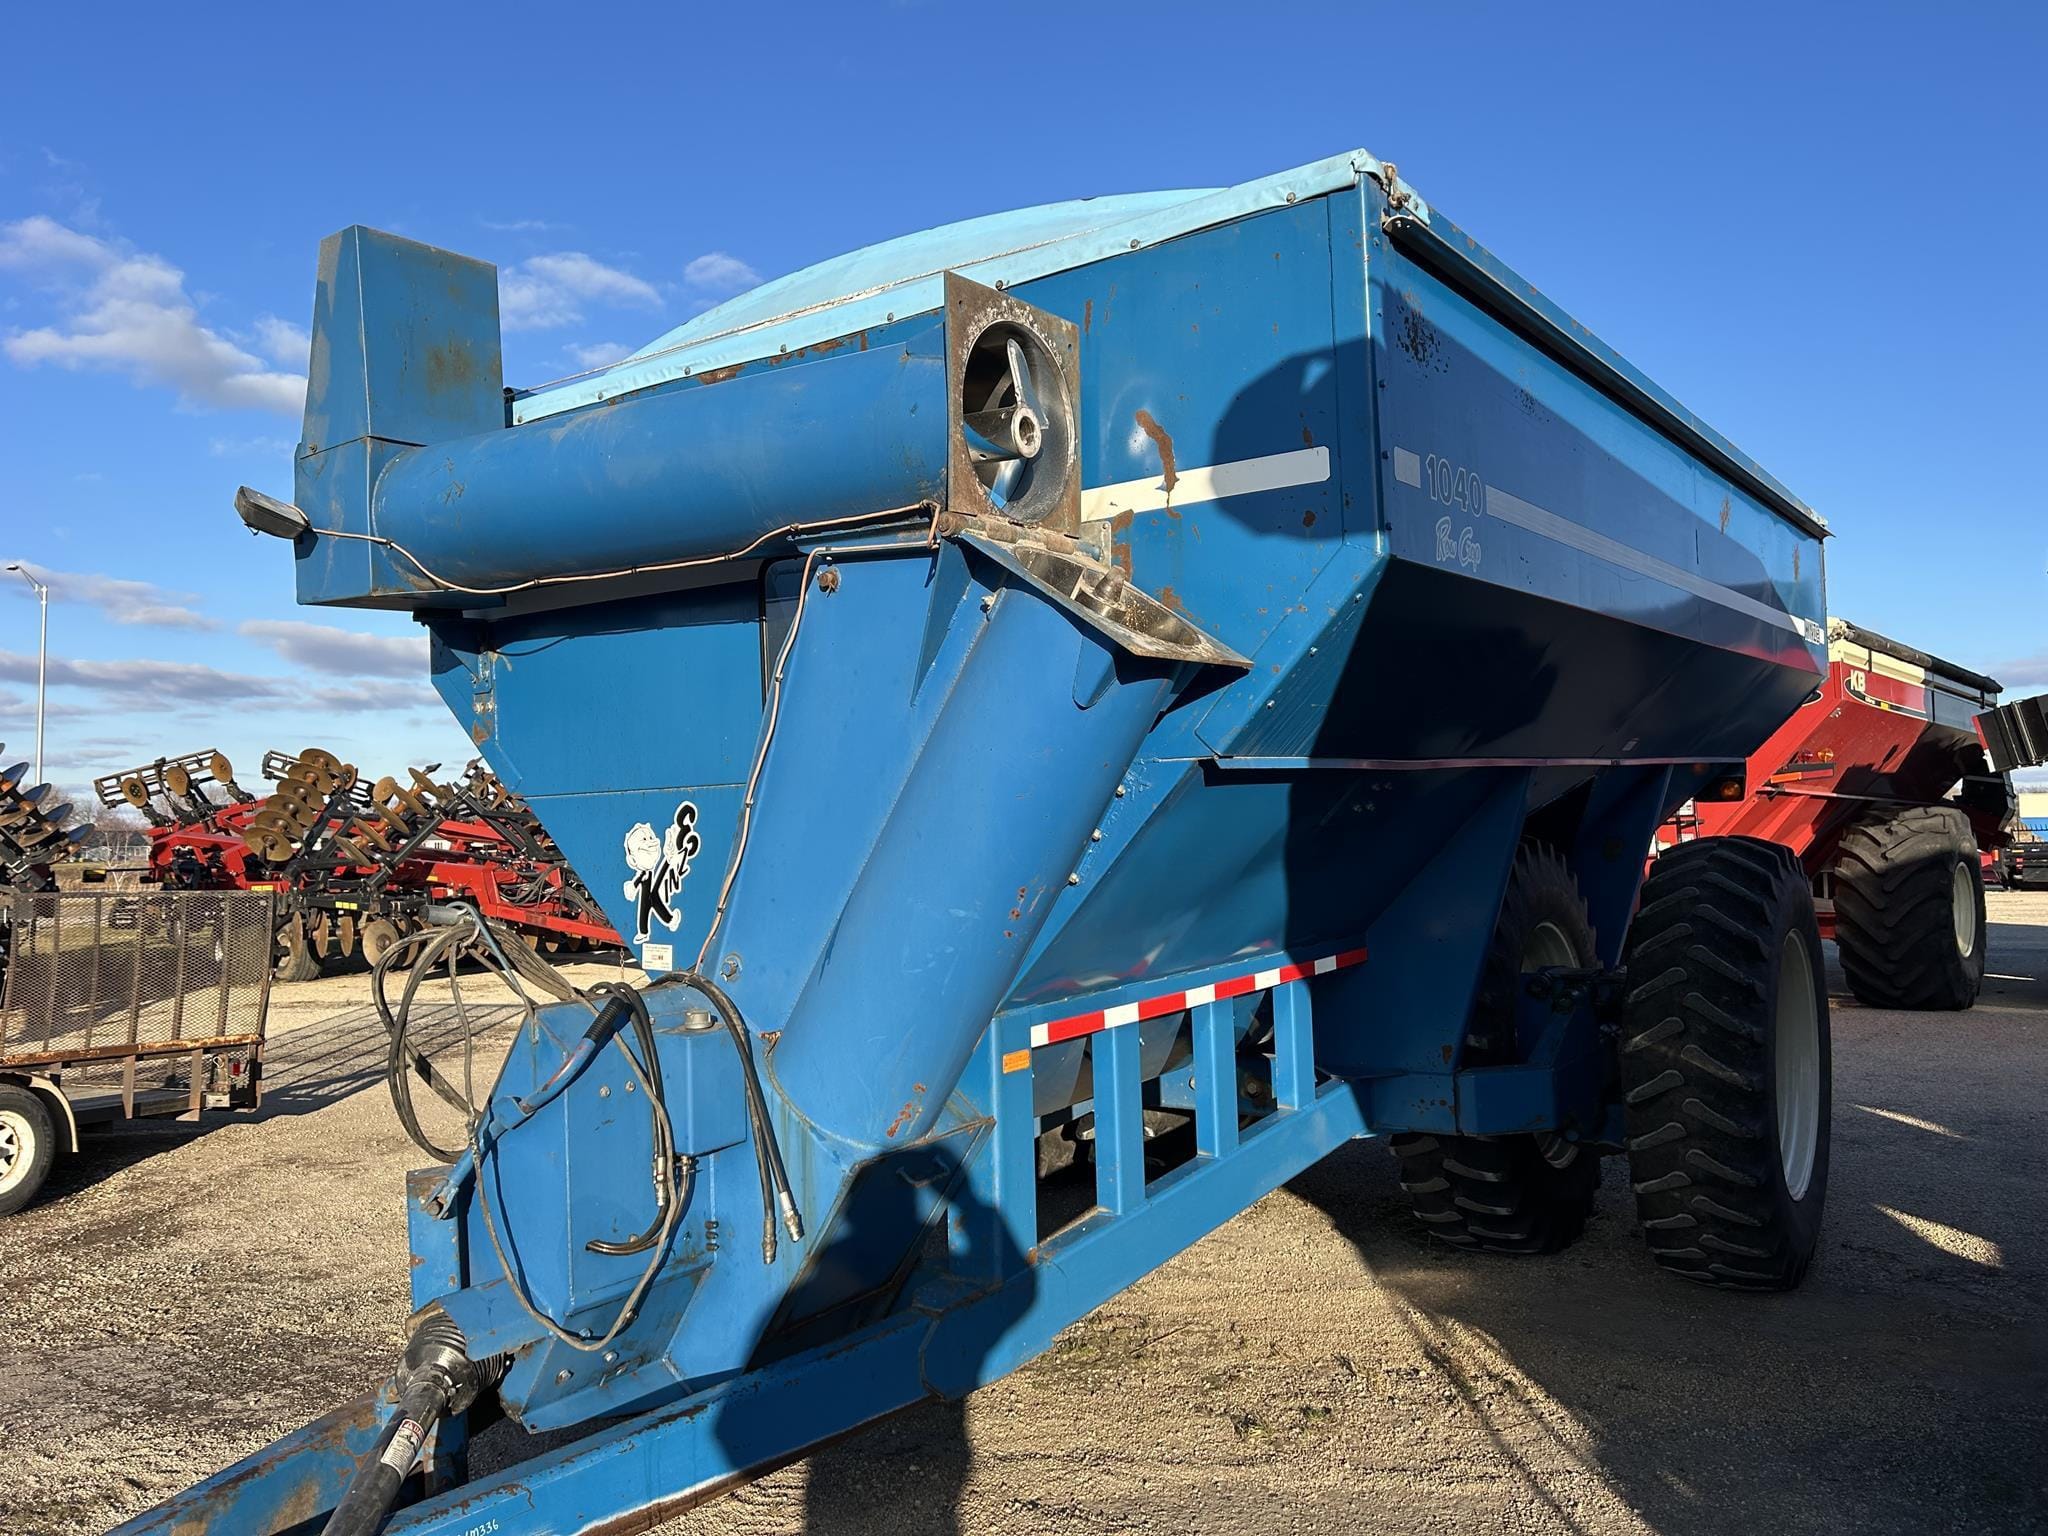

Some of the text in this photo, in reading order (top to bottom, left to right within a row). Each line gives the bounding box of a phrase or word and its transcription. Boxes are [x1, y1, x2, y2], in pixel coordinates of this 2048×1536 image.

[1426, 454, 1483, 518] 1040
[1437, 516, 1457, 562] Row
[635, 804, 699, 935] KINZE
